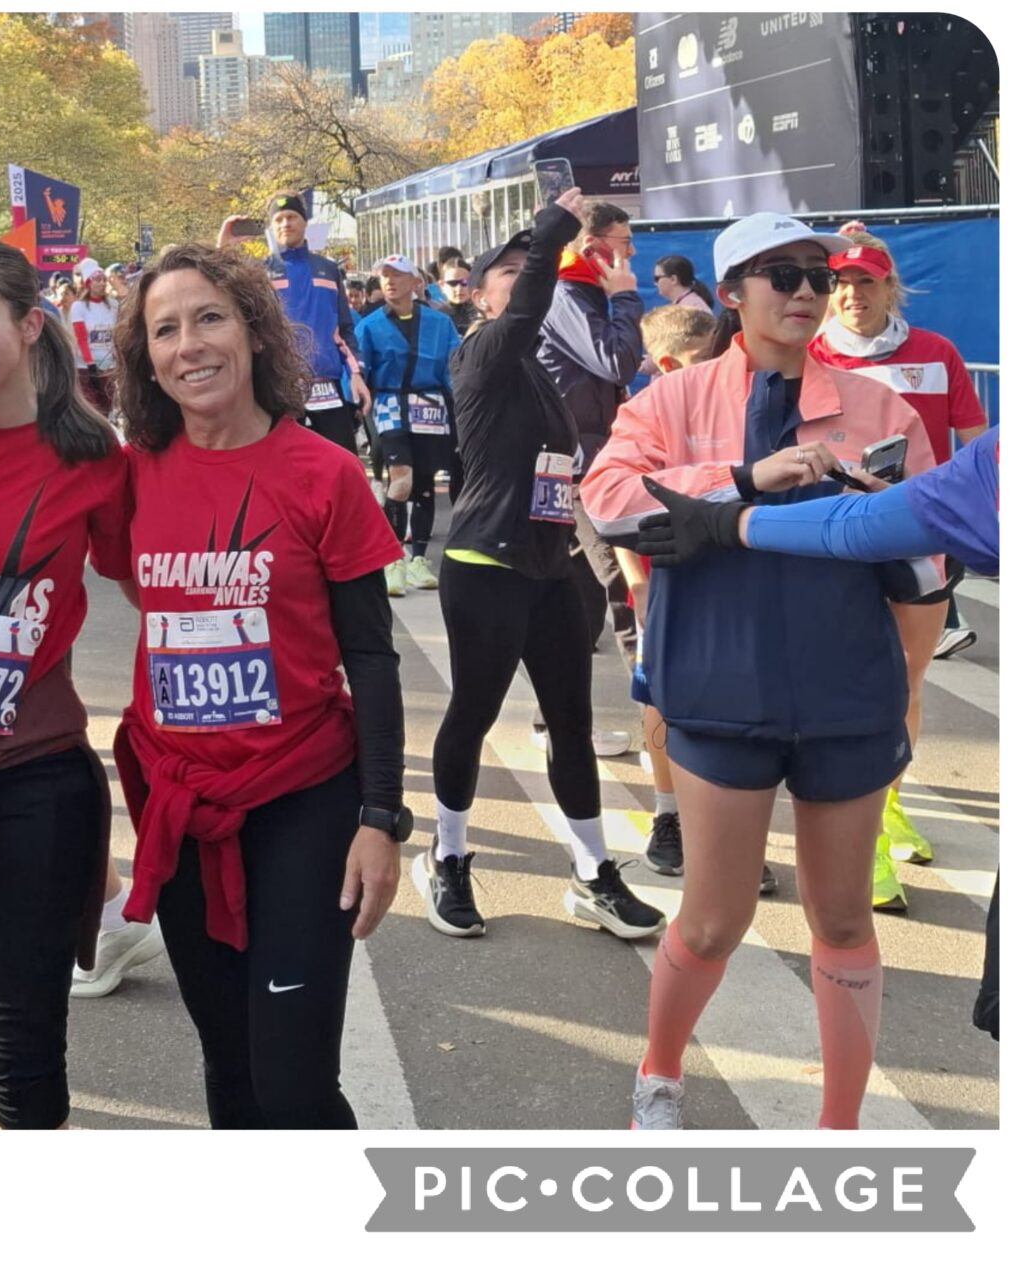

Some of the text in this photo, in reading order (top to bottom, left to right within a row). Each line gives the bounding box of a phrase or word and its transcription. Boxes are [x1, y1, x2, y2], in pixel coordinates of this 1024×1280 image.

[761, 13, 807, 36] UNITED
[13, 172, 23, 201] 2025
[138, 550, 274, 588] CHANWAS
[173, 658, 270, 707] 13912
